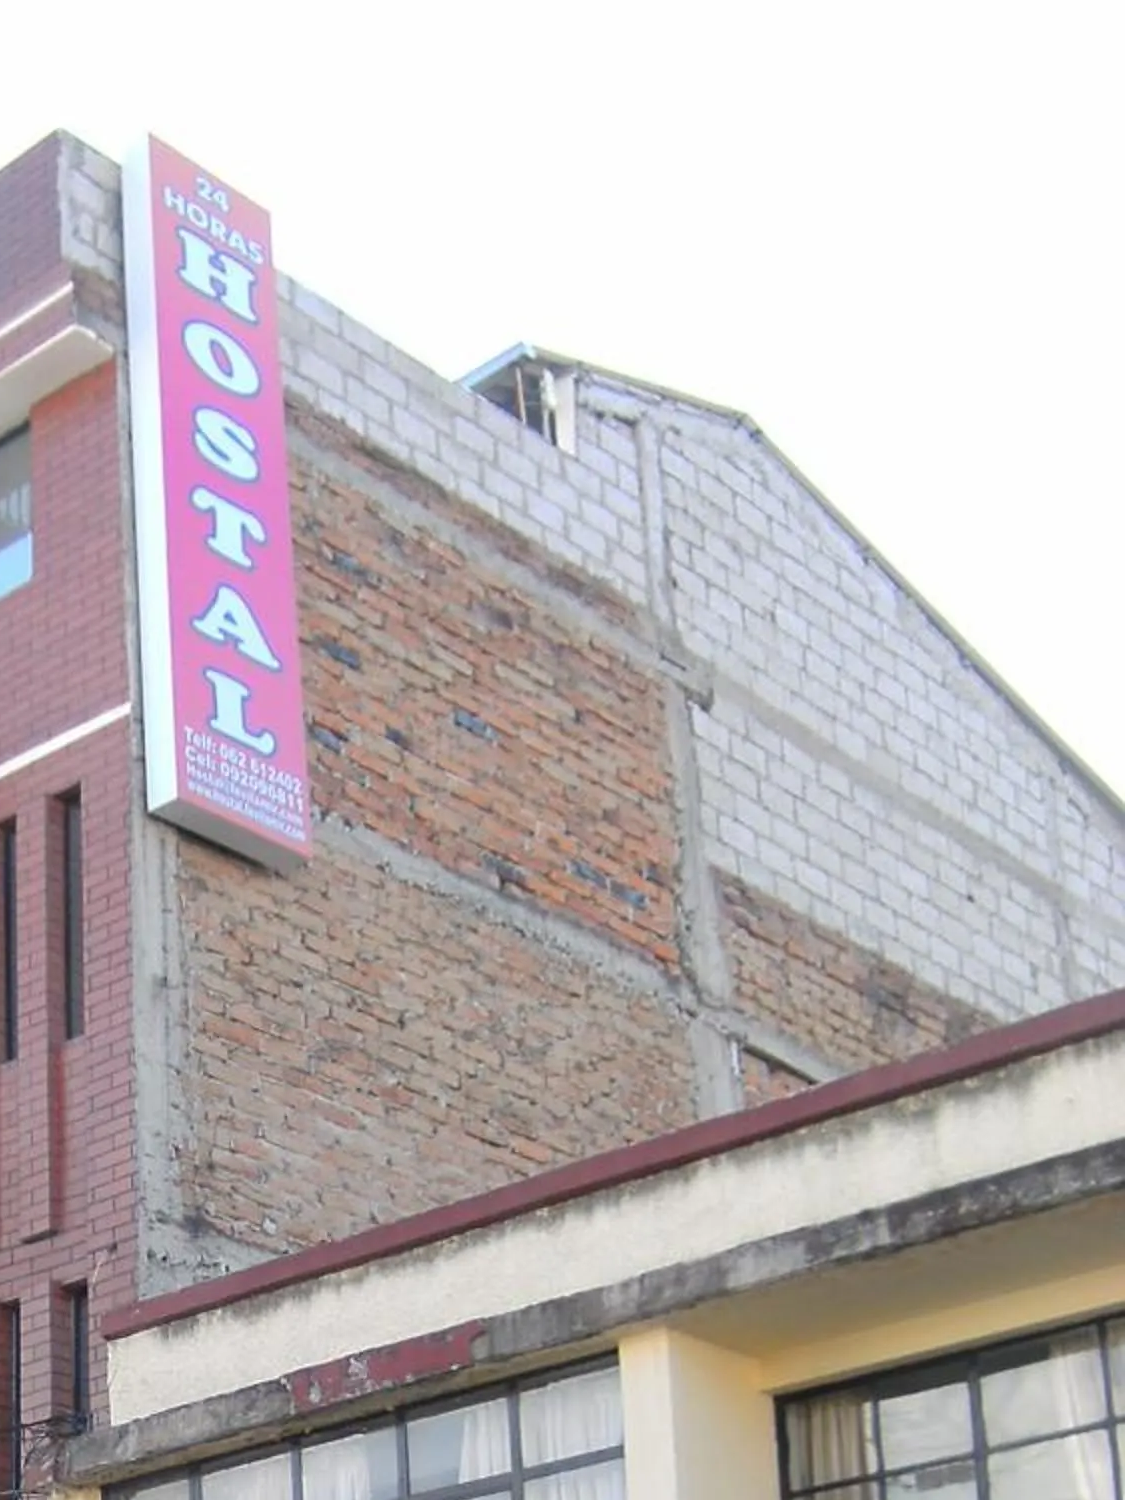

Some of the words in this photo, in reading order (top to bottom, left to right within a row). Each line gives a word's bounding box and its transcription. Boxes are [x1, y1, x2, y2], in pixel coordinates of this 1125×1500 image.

[163, 186, 265, 265] HORAS
[195, 175, 230, 212] 24
[176, 224, 282, 757] HOSTAL
